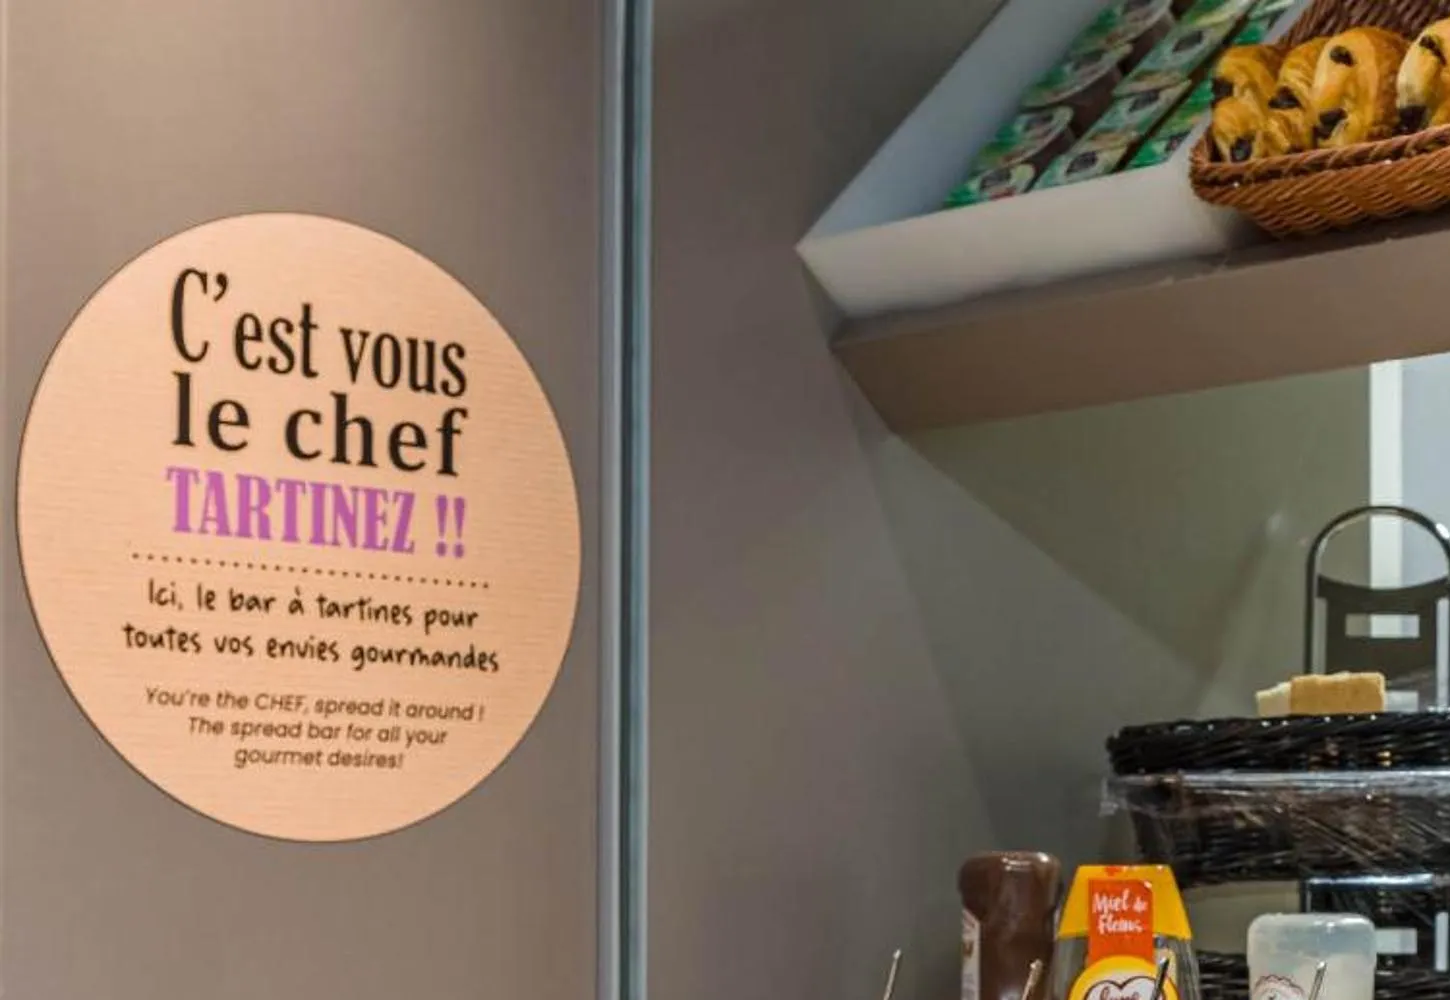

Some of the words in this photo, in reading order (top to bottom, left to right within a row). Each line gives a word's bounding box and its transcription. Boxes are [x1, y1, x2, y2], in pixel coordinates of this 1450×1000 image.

[339, 327, 468, 398] vous
[172, 370, 252, 452] le
[284, 390, 468, 477] chef
[166, 466, 415, 554] TARTINEZ
[148, 577, 184, 611] Ici,
[196, 582, 216, 612] le
[228, 587, 276, 613] bar
[288, 585, 304, 615] à
[316, 594, 413, 626] tartines
[424, 608, 479, 636] pour
[122, 622, 202, 655] toutes
[214, 635, 254, 658] vos
[266, 635, 340, 663] envies
[351, 643, 500, 673] gourmandes
[188, 715, 224, 735] The
[230, 720, 303, 742] spread
[307, 720, 341, 740] bar
[346, 722, 373, 742] for
[377, 725, 401, 743] all
[405, 729, 449, 749] your
[215, 688, 248, 710] the
[254, 692, 310, 716] CHEF,
[314, 697, 384, 719] spread
[388, 698, 401, 718] it
[405, 702, 474, 721] around
[234, 747, 323, 770] gourmet
[327, 749, 404, 769] desires!
